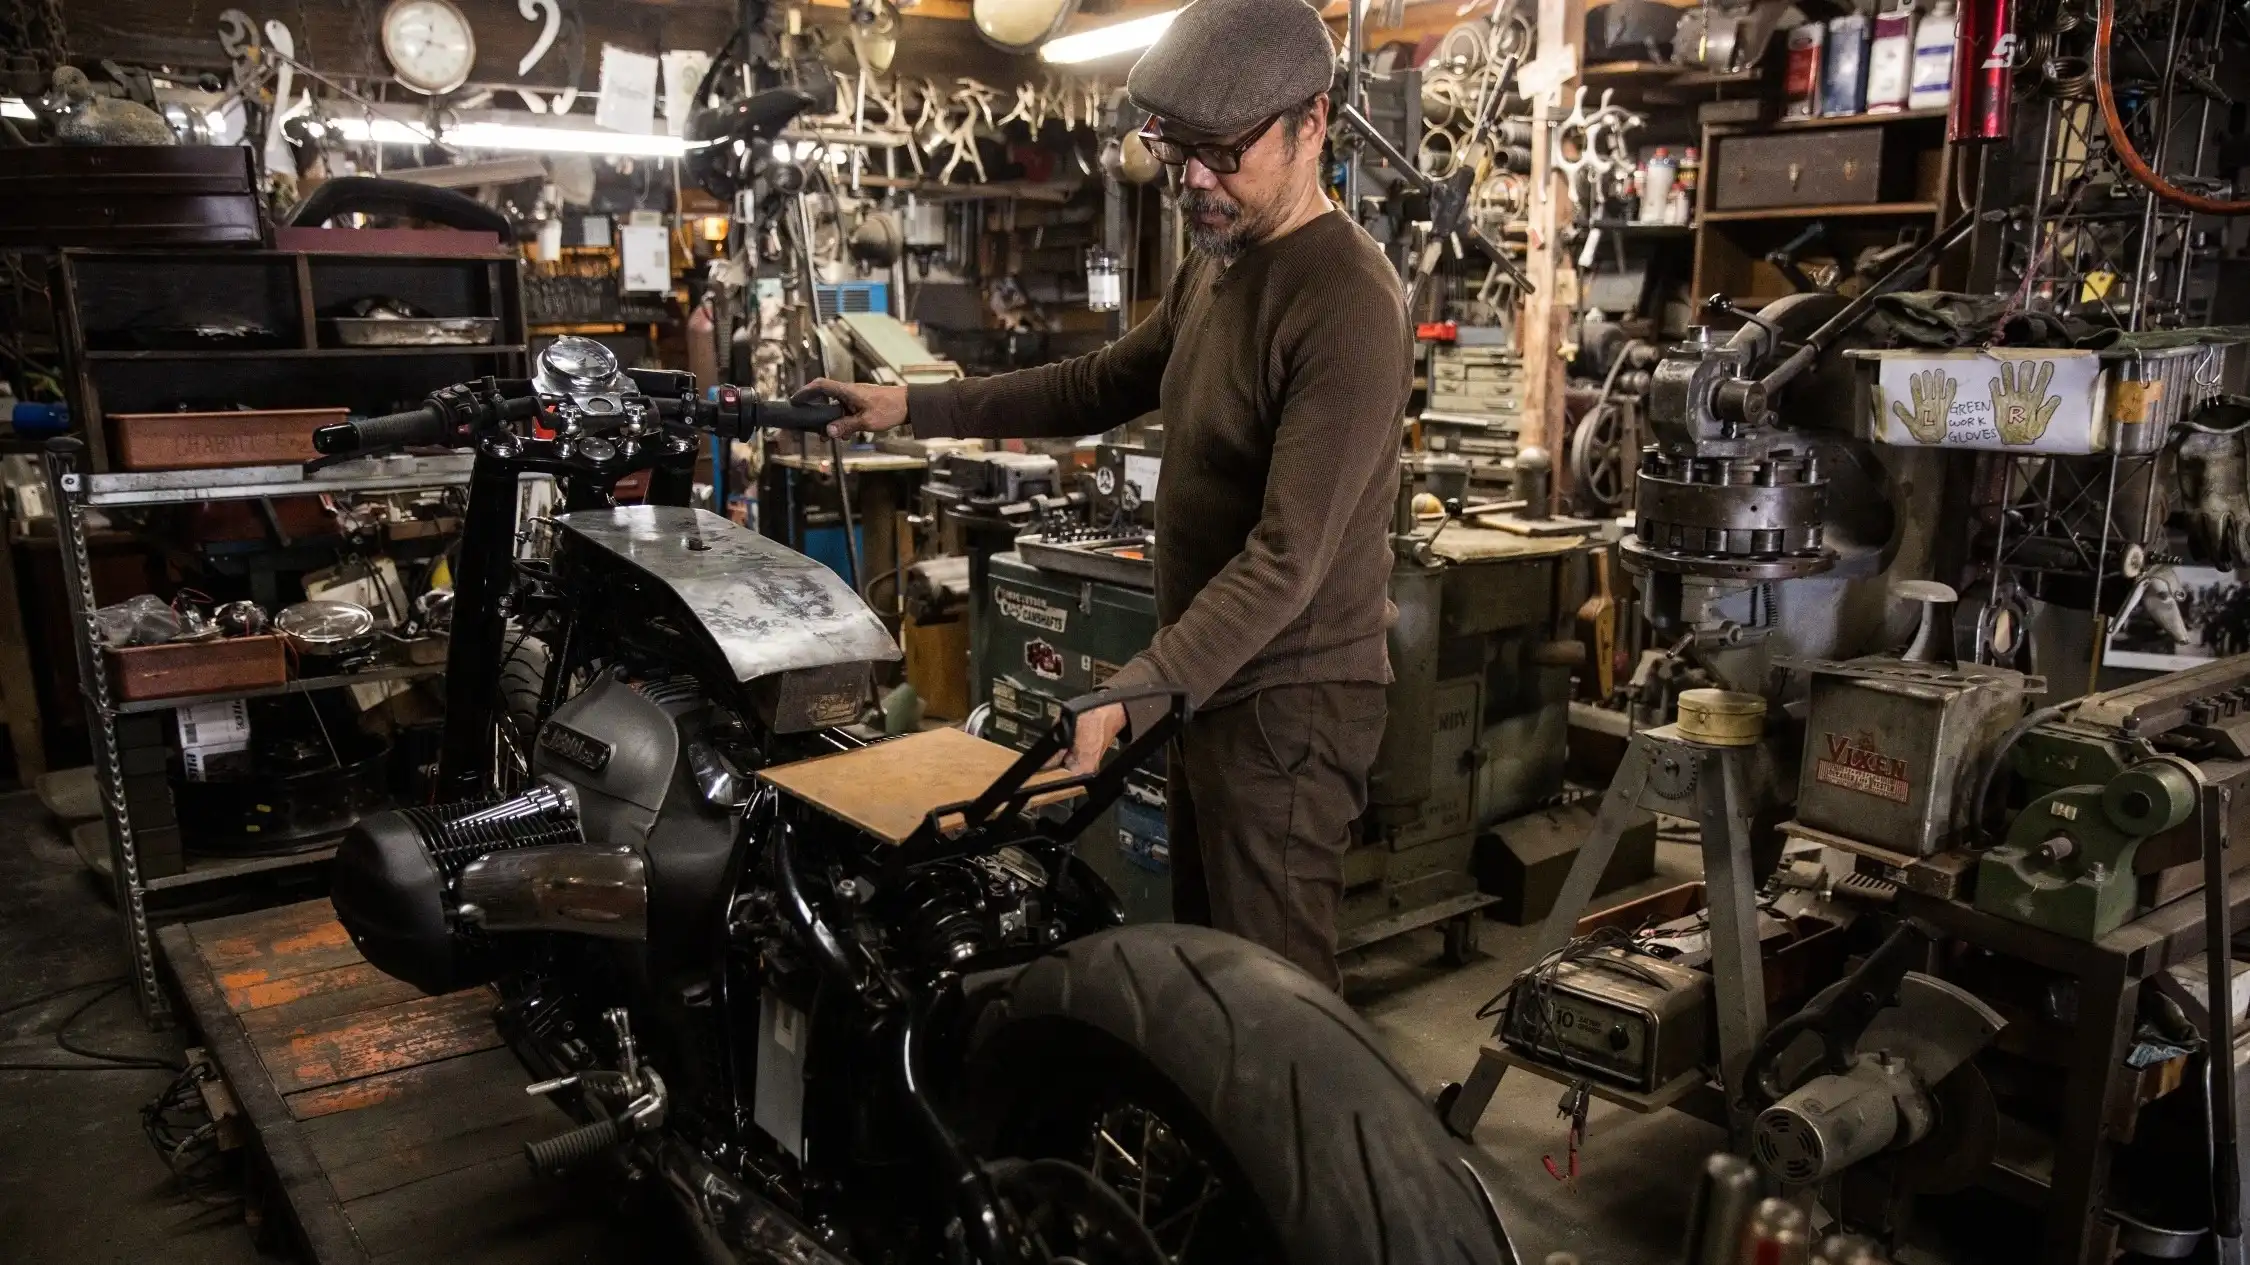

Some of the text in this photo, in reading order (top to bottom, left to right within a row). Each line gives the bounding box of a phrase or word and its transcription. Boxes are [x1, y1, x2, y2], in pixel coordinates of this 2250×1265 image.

[1949, 400, 1992, 414] GREEN
[1948, 417, 1987, 427] WORK
[2007, 406, 2026, 424] R
[1948, 428, 1996, 443] GLOVES
[1555, 1010, 1574, 1028] 10
